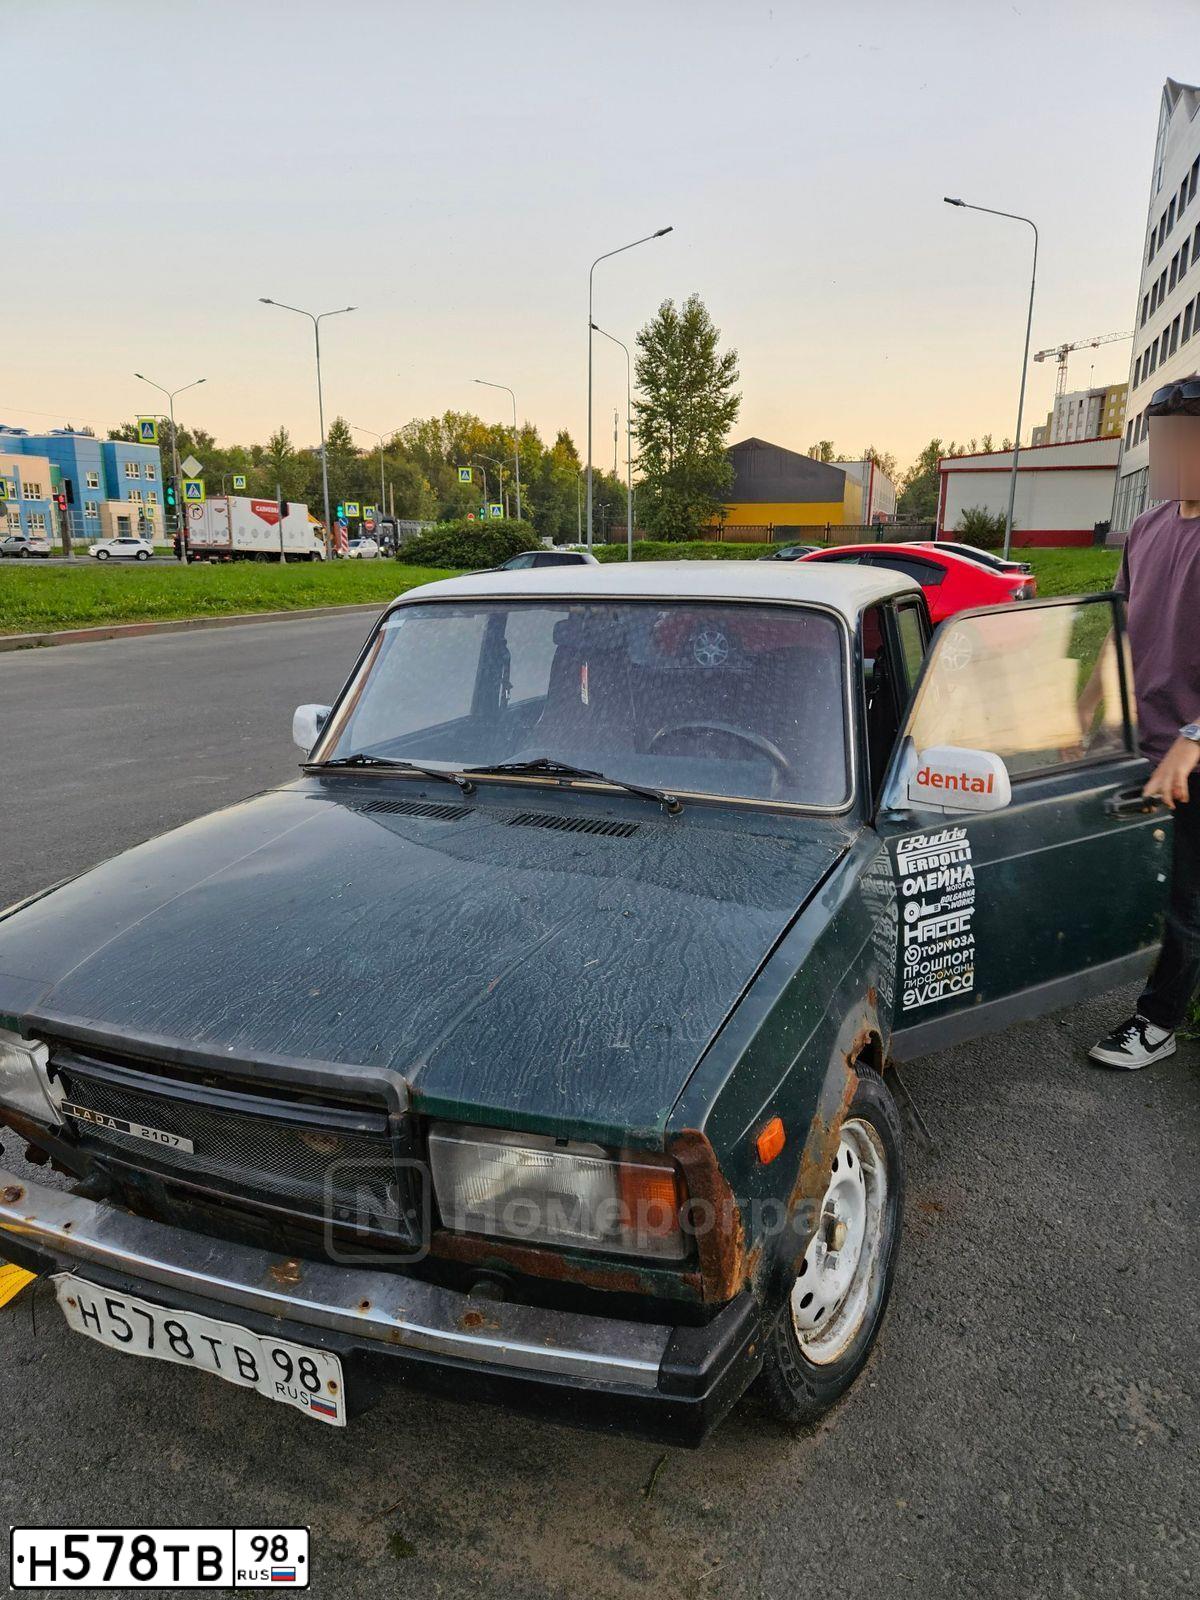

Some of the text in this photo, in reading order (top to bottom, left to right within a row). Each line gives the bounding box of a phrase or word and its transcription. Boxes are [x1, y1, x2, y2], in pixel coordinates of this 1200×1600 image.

[916, 767, 994, 794] dental
[902, 863, 975, 897] ОЛЕЙНА
[945, 882, 966, 892] MOTOR
[940, 889, 976, 904] BOLGARKA
[922, 933, 975, 957] ТОРМОЗА
[903, 948, 975, 980] ПРОШПОРТ
[72, 1106, 181, 1147] LADA 2107
[271, 1348, 322, 1394] 98
[274, 1381, 310, 1406] RUS
